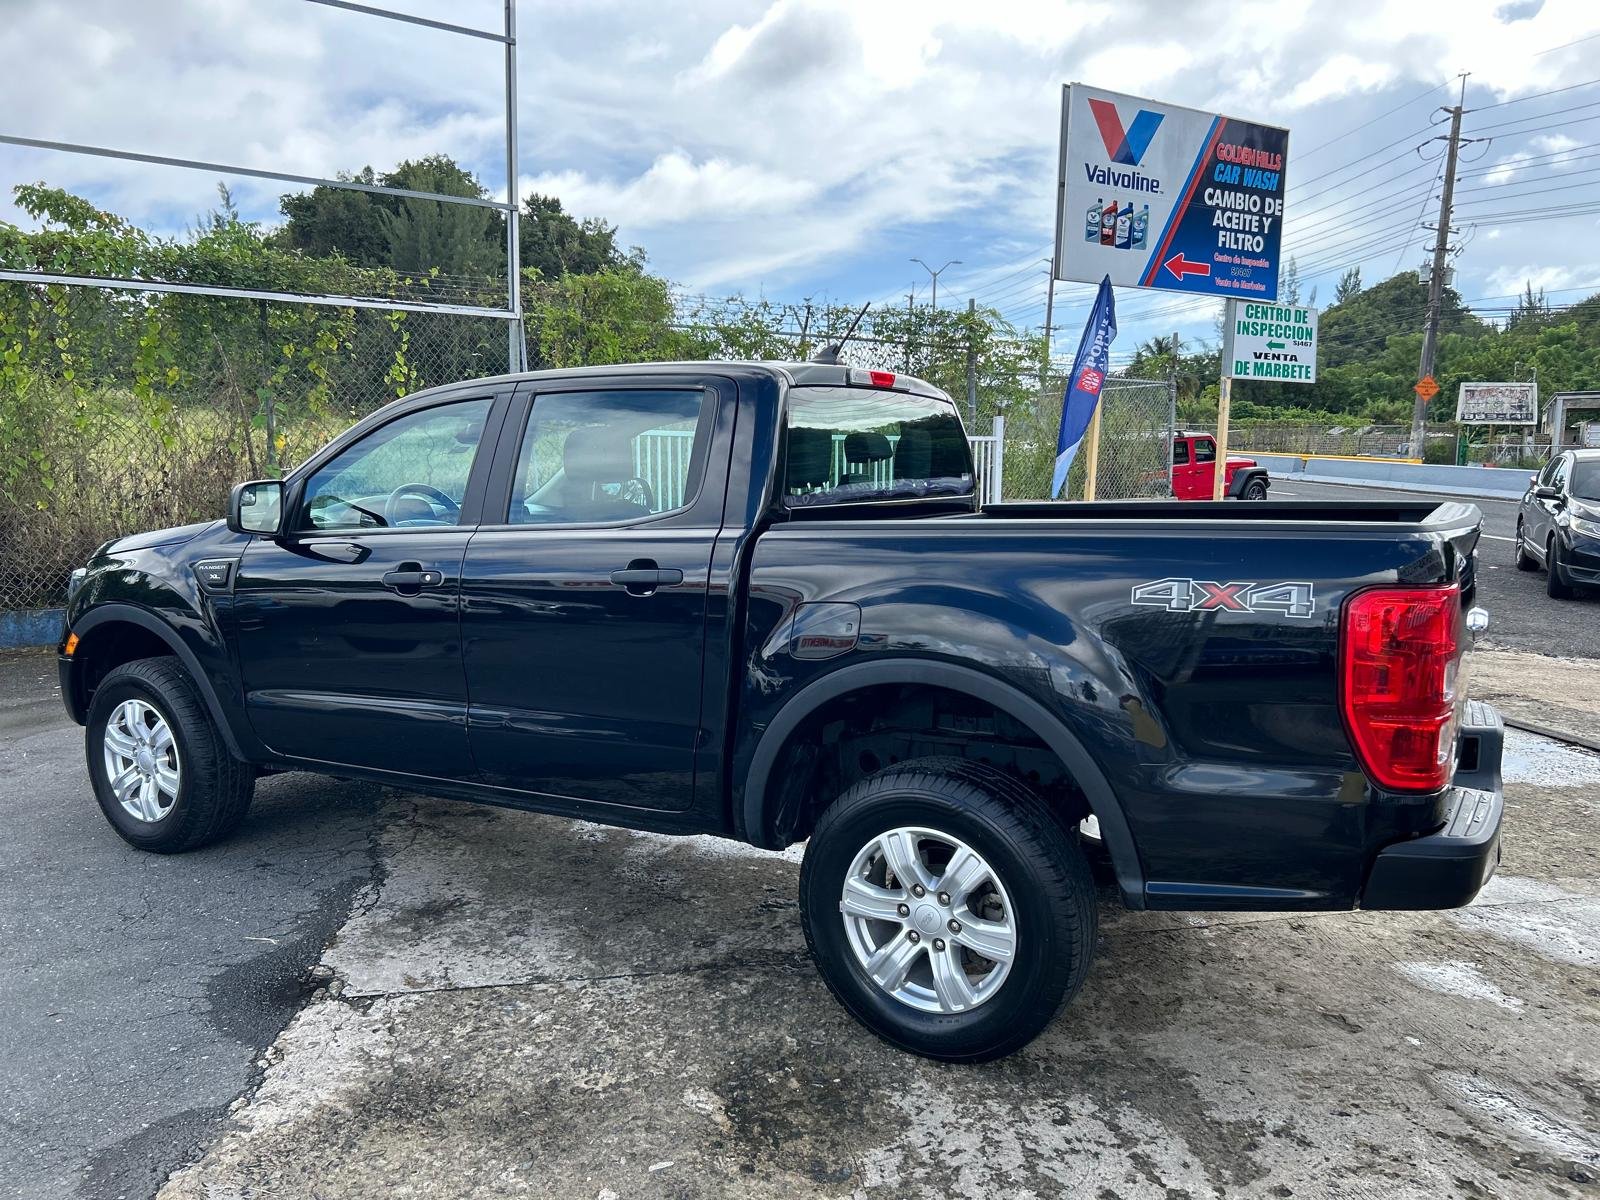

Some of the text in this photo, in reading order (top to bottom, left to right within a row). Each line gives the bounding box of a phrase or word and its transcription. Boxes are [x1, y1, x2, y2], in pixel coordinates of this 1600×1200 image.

[1084, 162, 1160, 194] Valvoline
[1213, 163, 1280, 191] CAR WASH
[1204, 187, 1283, 216] CAMBIO DE
[1212, 209, 1272, 234] ACEITE Y
[1218, 230, 1264, 253] FILTRO
[1245, 303, 1308, 324] CENTRO DE
[1236, 320, 1313, 341] INSPECCION
[1253, 351, 1298, 362] VENTA
[1234, 360, 1311, 380] DE MARBETE
